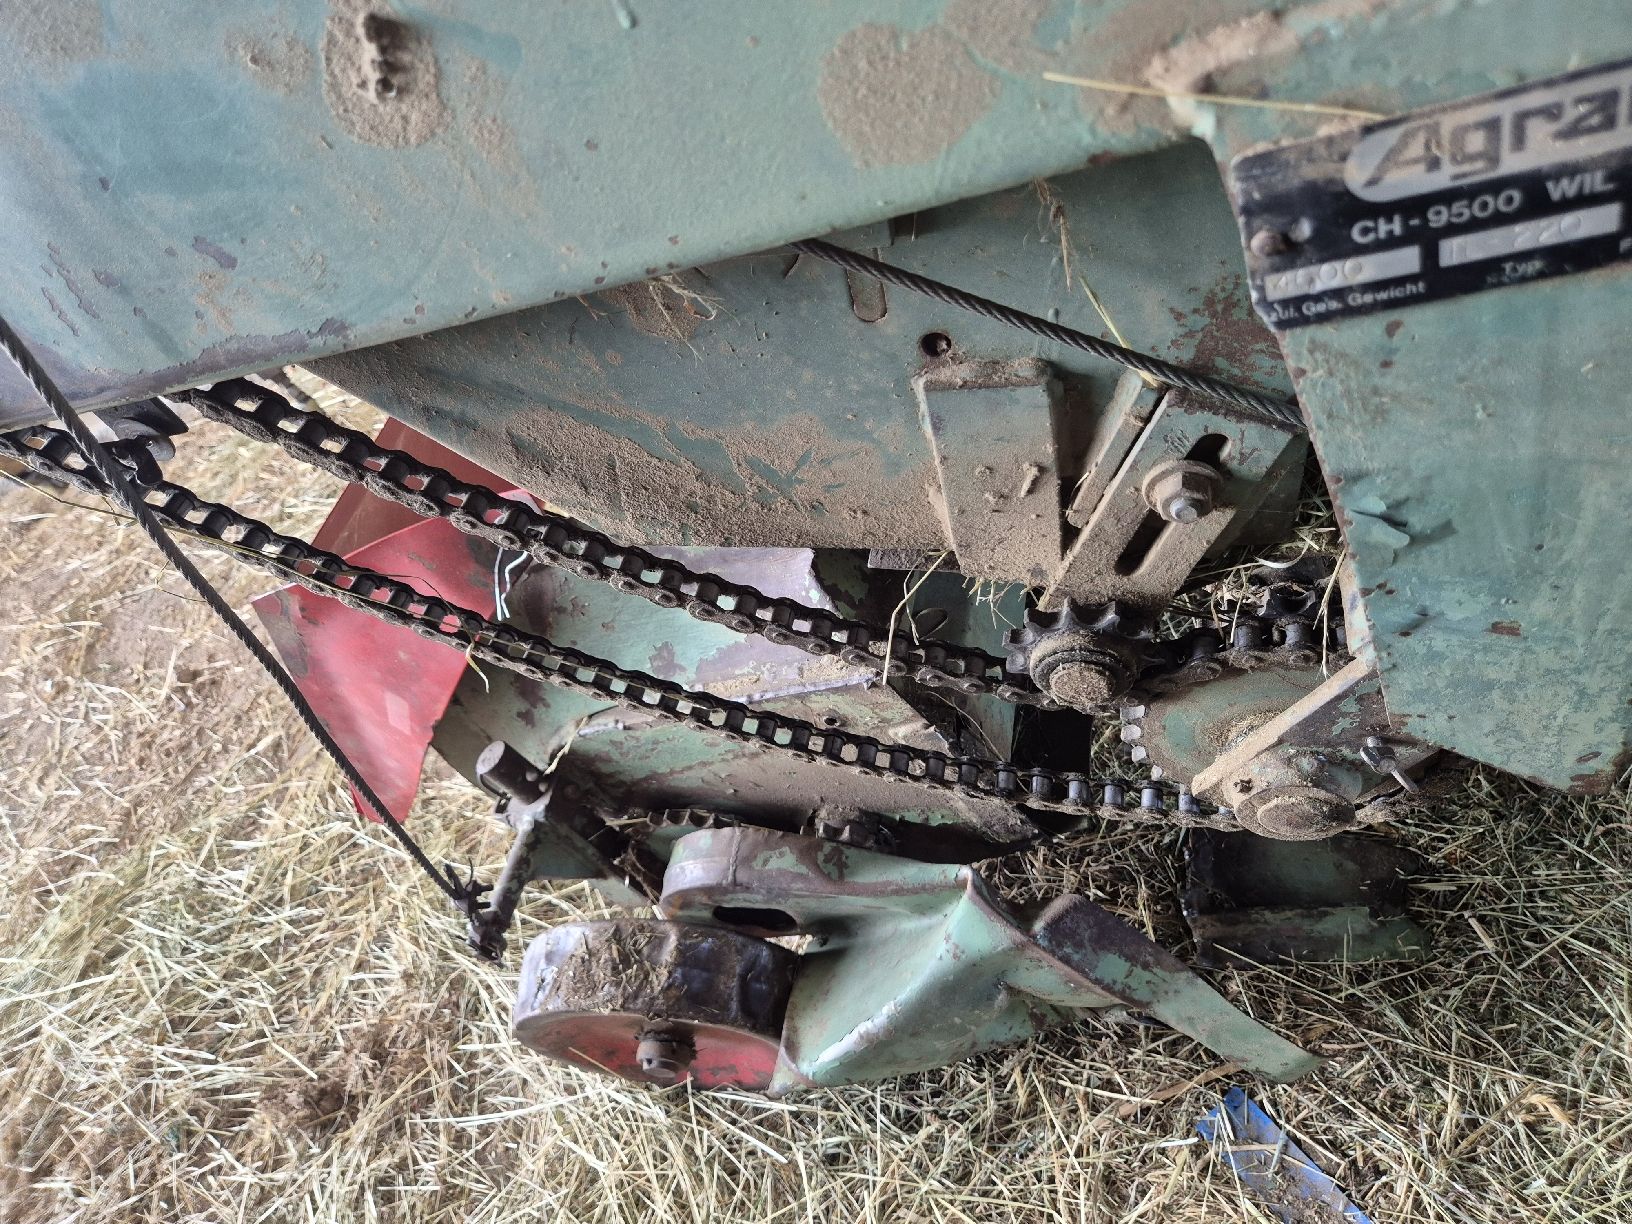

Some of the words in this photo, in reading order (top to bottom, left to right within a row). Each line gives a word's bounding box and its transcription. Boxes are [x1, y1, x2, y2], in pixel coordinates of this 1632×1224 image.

[1364, 86, 1632, 188] Agra
[1546, 170, 1616, 202] WIL
[1347, 281, 1427, 306] Gewicht
